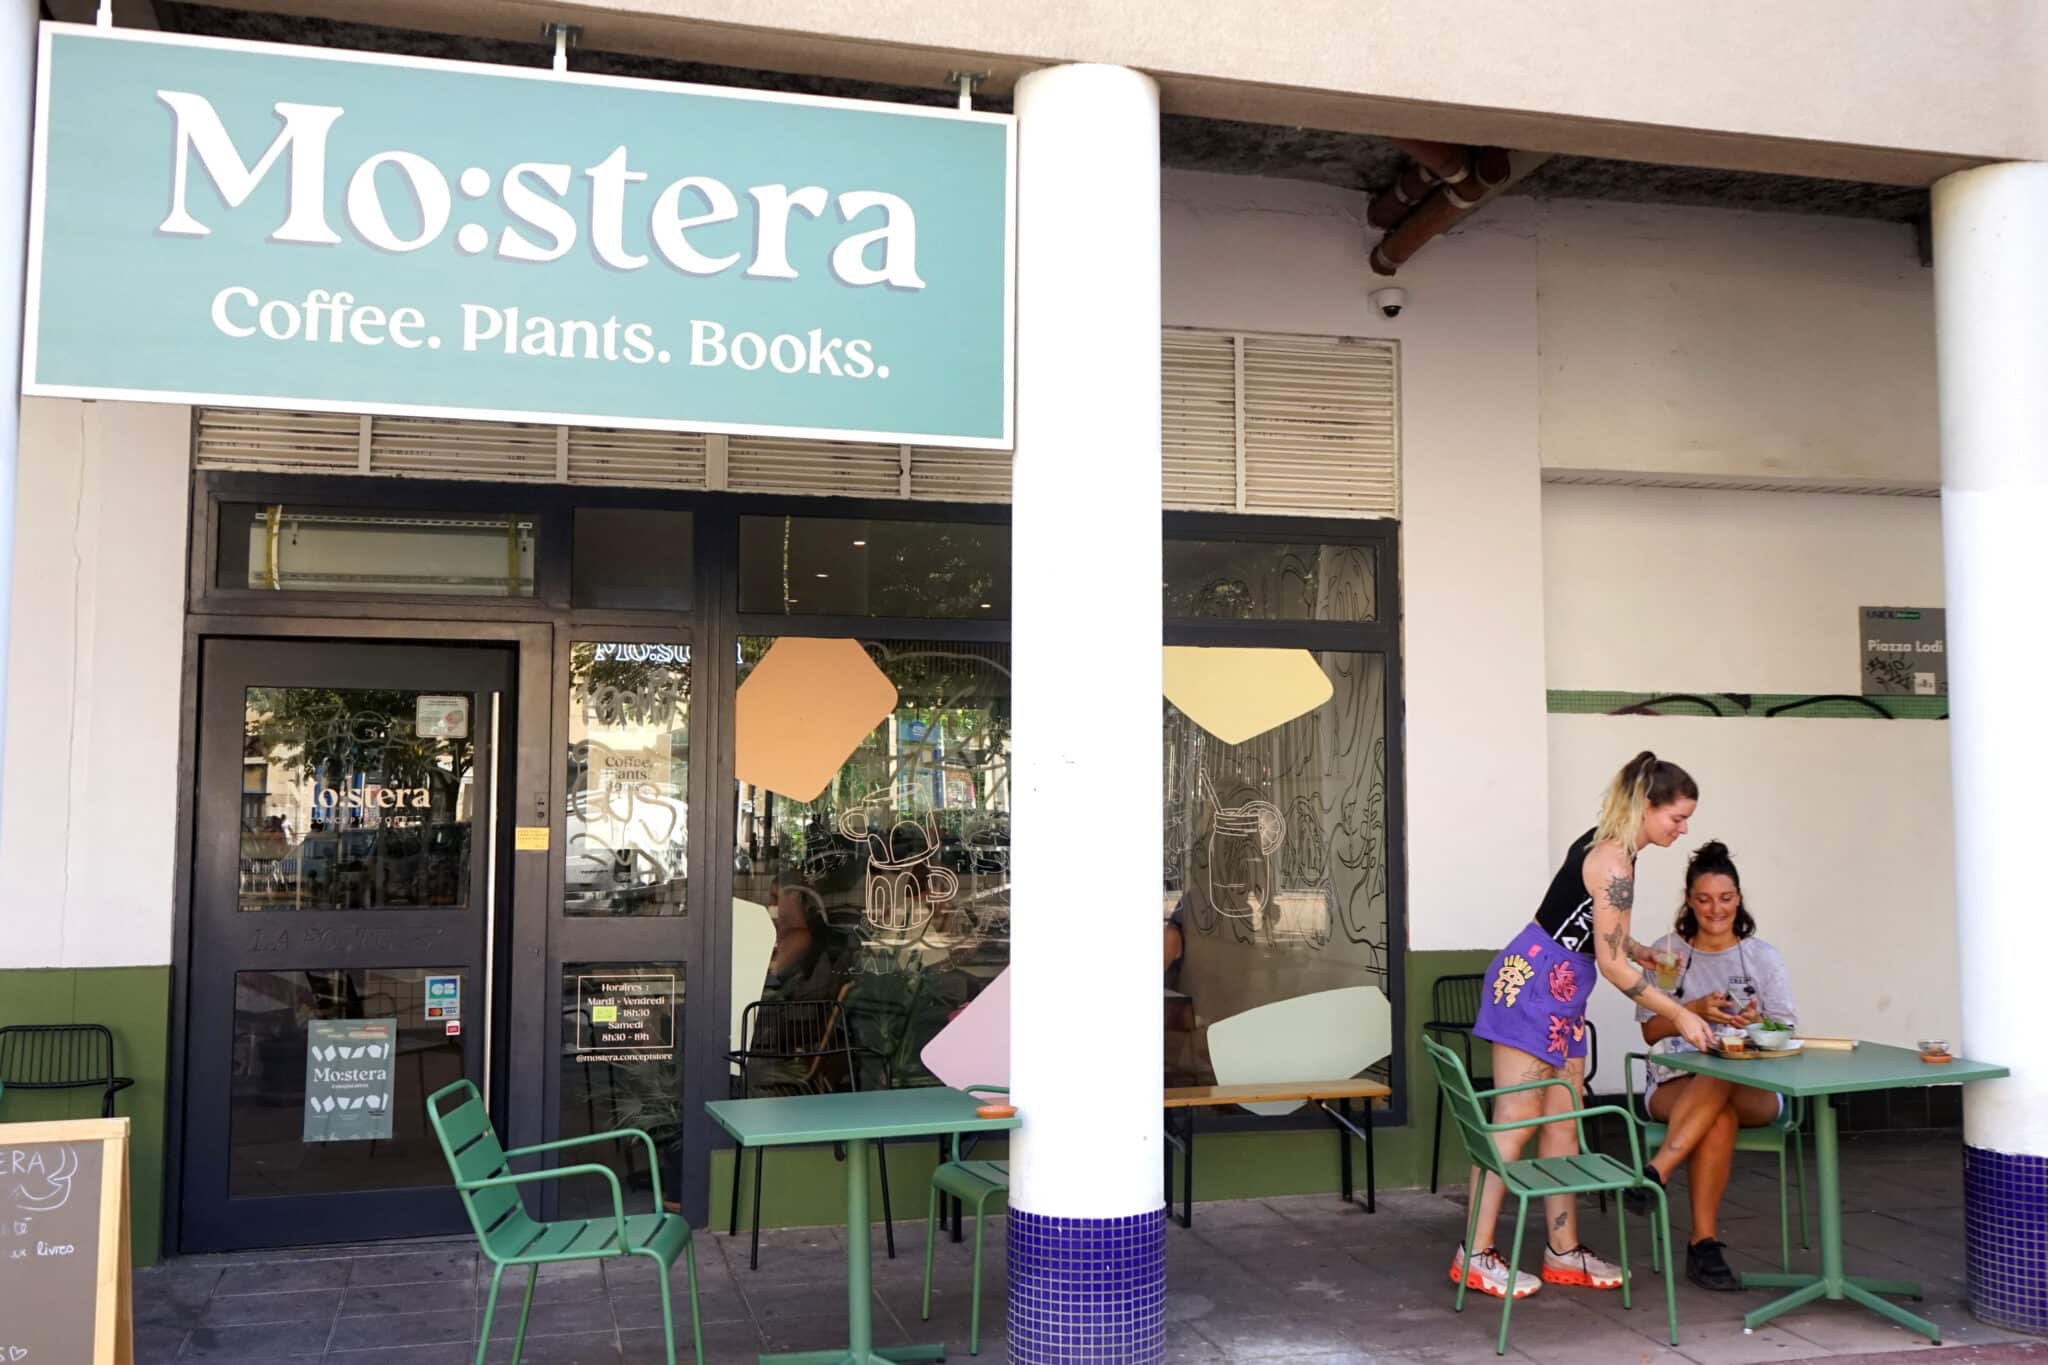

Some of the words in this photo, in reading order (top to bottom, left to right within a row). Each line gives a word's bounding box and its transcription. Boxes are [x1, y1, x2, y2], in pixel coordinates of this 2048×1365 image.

[156, 89, 926, 291] Mo:stera
[210, 285, 442, 351] Coffee.
[461, 303, 671, 366] Plants.
[689, 319, 892, 380] Books.
[1867, 639, 1912, 652] Piazza
[1915, 640, 1944, 653] Lodi
[588, 997, 615, 1006] Mardi
[623, 996, 665, 1005] Vendredi
[608, 1020, 644, 1029] Samedi
[313, 1067, 387, 1082] Mo:stera
